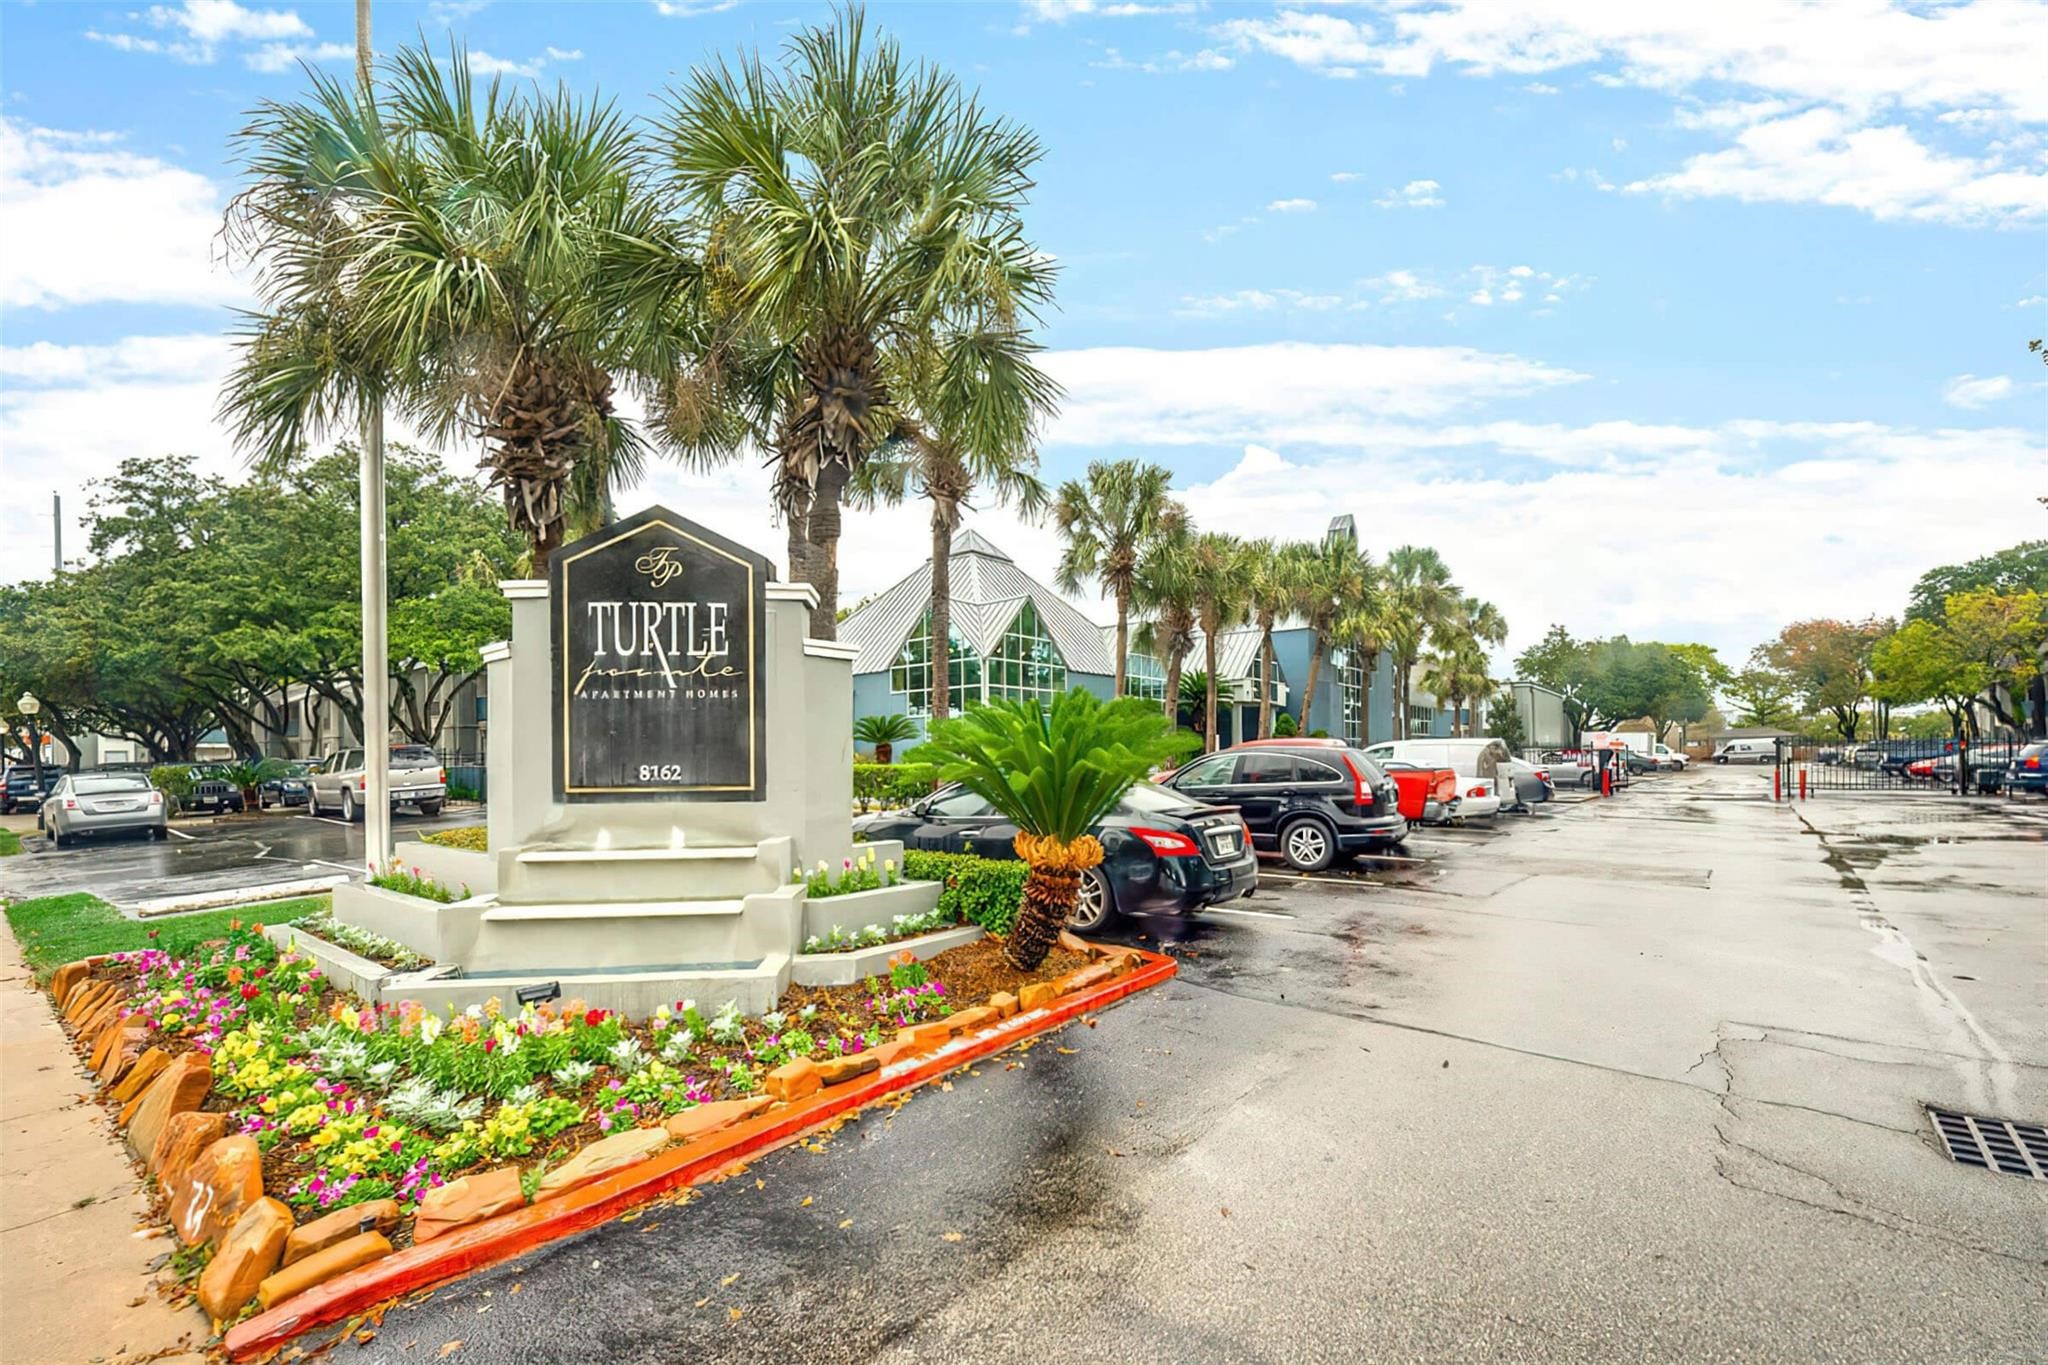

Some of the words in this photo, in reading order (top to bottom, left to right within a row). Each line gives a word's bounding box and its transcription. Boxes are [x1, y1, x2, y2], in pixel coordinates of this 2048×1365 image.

[587, 602, 729, 688] TURTLE
[579, 690, 677, 699] APARTMENT
[685, 689, 739, 698] HOMES
[639, 764, 682, 782] 8162
